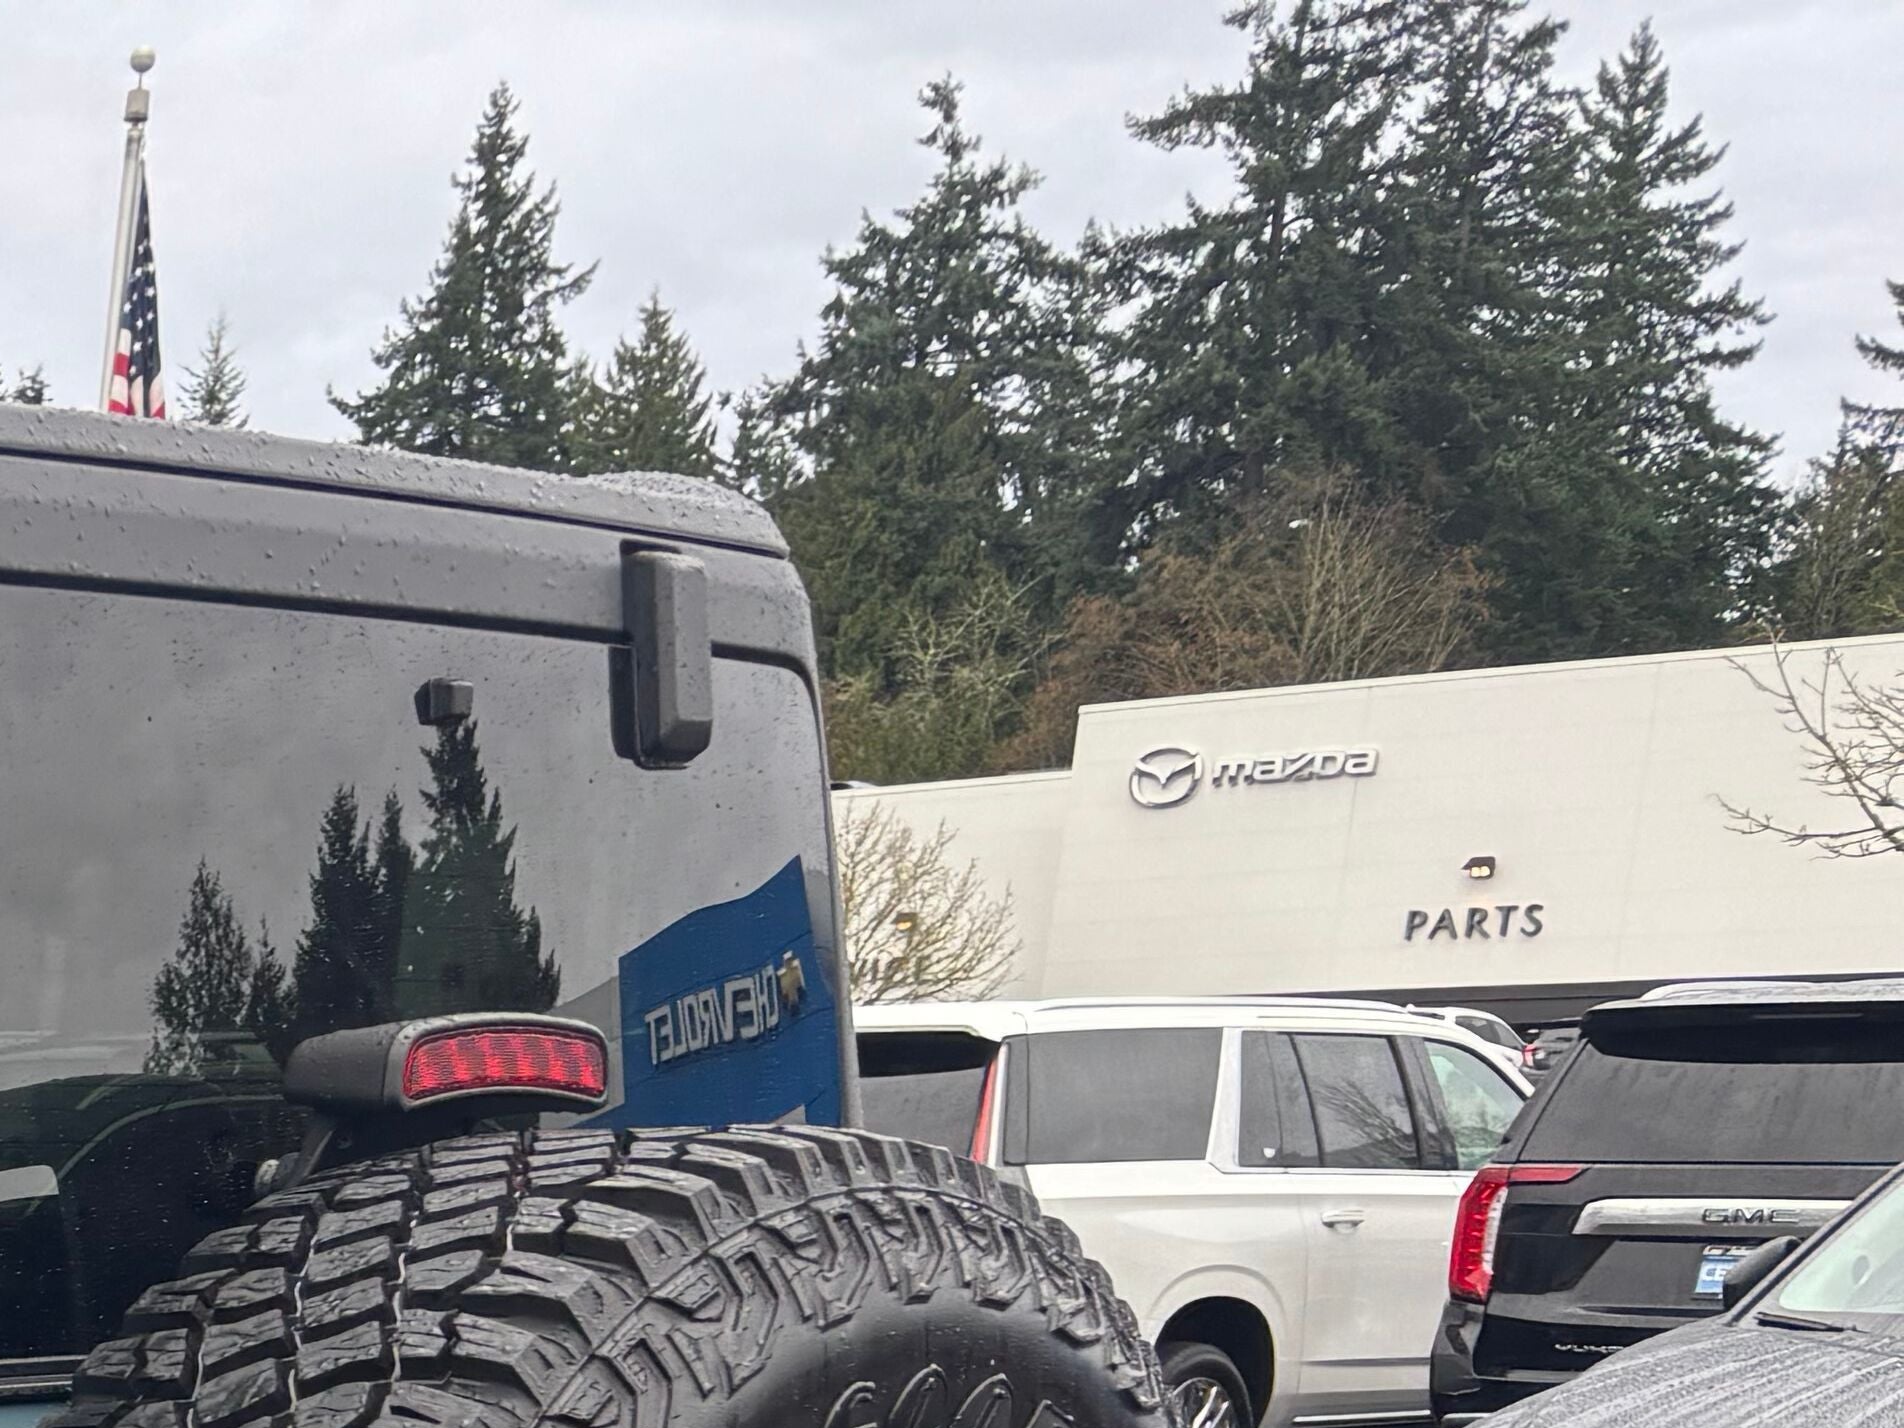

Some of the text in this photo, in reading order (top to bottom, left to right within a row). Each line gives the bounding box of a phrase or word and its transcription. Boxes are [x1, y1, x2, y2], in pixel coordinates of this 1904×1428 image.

[1212, 748, 1379, 788] mazda
[1404, 904, 1544, 941] PARTS
[1701, 1207, 1799, 1225] GMC
